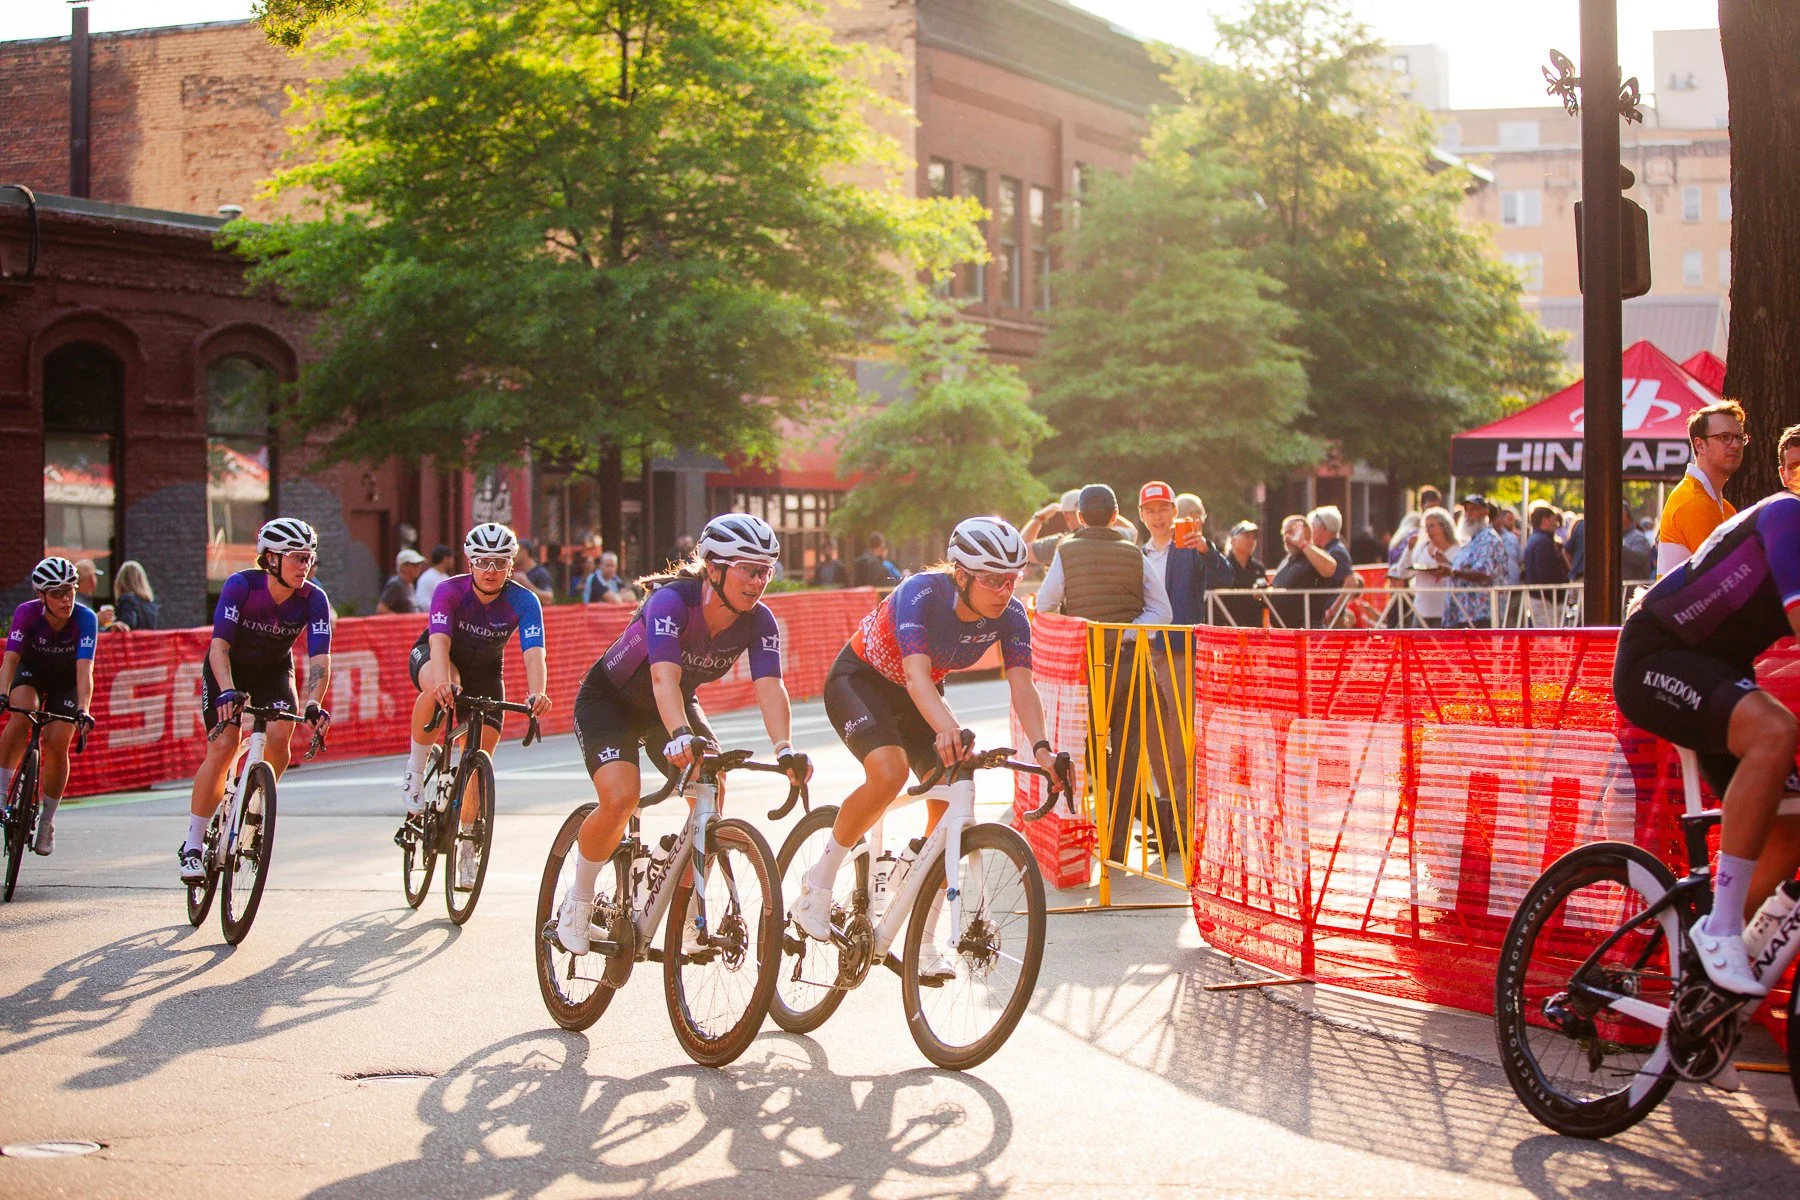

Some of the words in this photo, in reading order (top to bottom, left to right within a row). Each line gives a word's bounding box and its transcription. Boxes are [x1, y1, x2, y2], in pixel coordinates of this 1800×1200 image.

[1496, 442, 1696, 472] HINAP
[1720, 563, 1752, 593] FEAR
[242, 619, 301, 636] KINGDOM
[458, 620, 508, 637] KINGDOM
[680, 650, 739, 670] INGDOM
[1643, 670, 1702, 711] KINGDOM
[644, 823, 690, 917] PINARELLO
[1505, 885, 1556, 1012] CARBONWORKS
[1752, 903, 1800, 982] INAR
